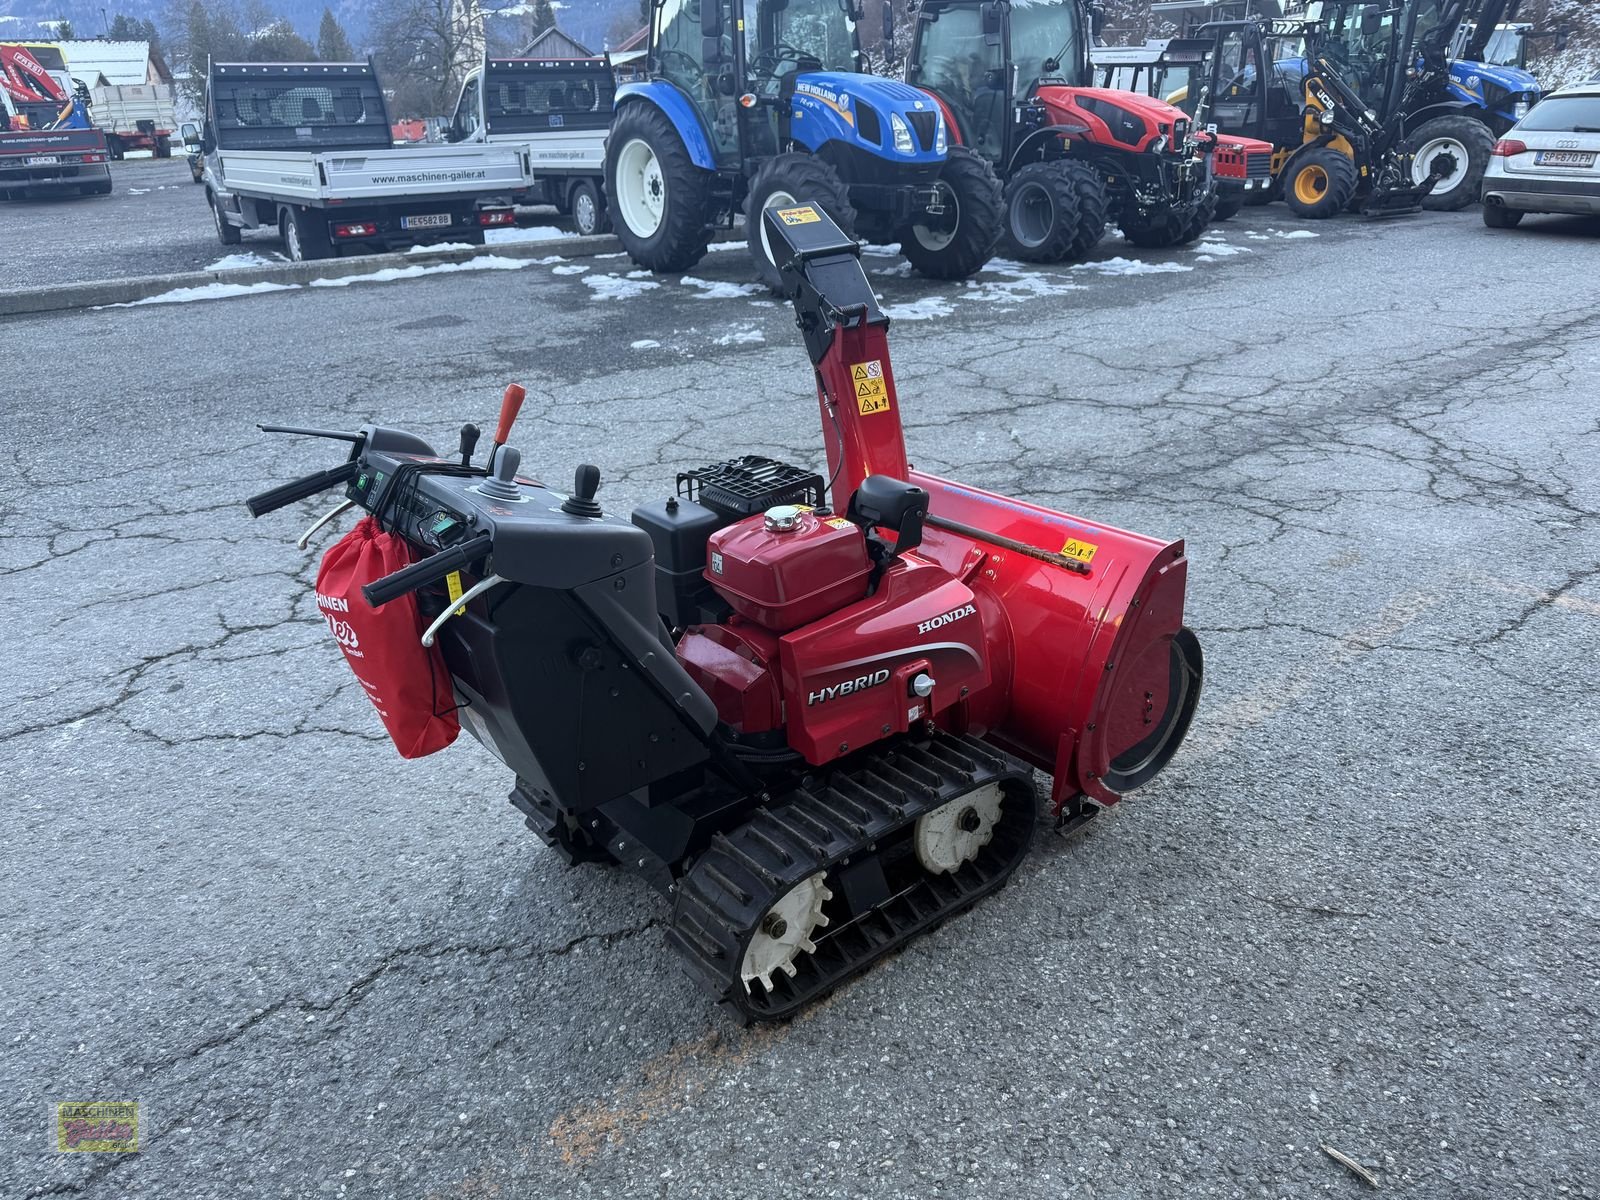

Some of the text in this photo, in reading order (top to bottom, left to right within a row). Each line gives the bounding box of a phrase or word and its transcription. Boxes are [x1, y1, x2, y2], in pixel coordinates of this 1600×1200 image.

[15, 53, 43, 75] FASSI
[797, 83, 837, 103] NEW HOLLAND
[1316, 89, 1335, 110] JCB
[371, 170, 486, 184] www.maschinen-gailer.at
[917, 604, 977, 635] HONDA
[807, 668, 891, 706] HYBRID
